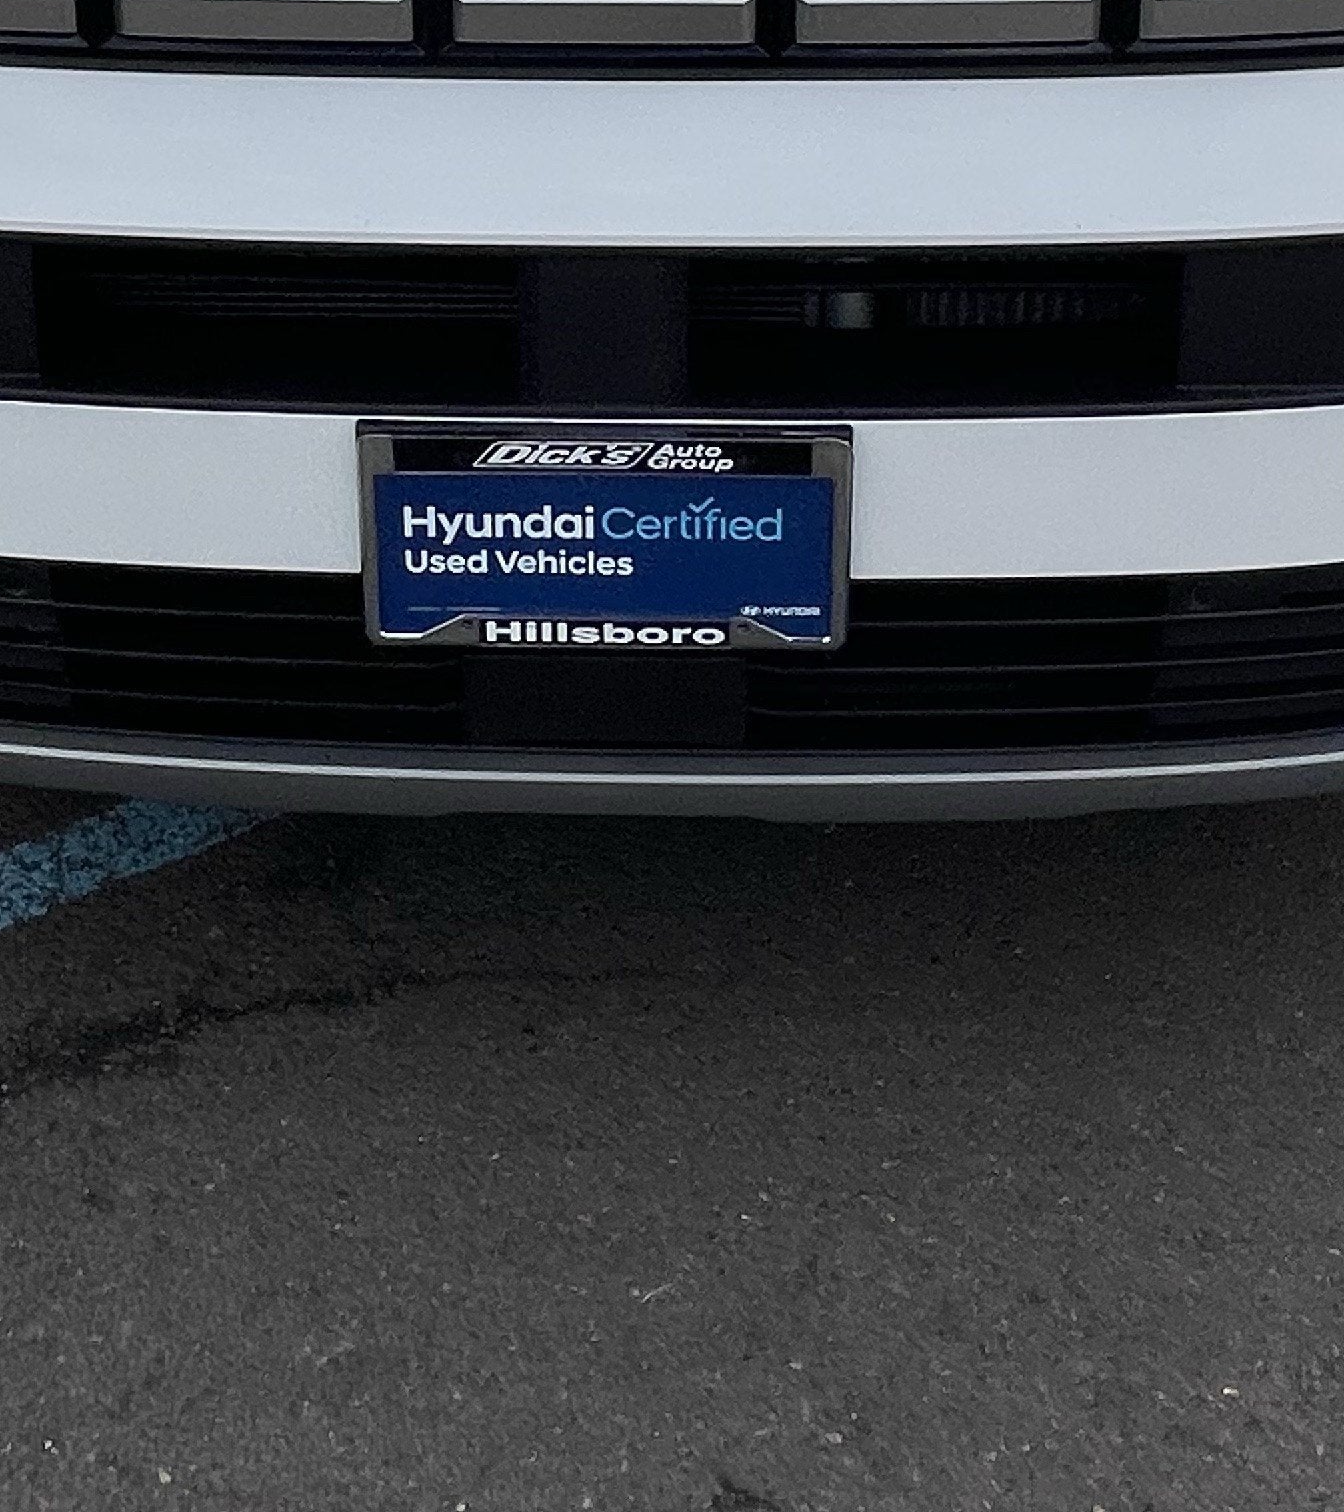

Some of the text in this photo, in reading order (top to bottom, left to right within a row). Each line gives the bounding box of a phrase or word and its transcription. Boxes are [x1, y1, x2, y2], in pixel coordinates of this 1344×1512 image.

[487, 442, 636, 465] Dick's
[655, 443, 723, 459] Auto
[647, 457, 735, 473] Group
[402, 499, 783, 545] Hyundai Certified
[404, 549, 635, 576] Used Vehicles
[485, 620, 727, 646] Hillsboro
